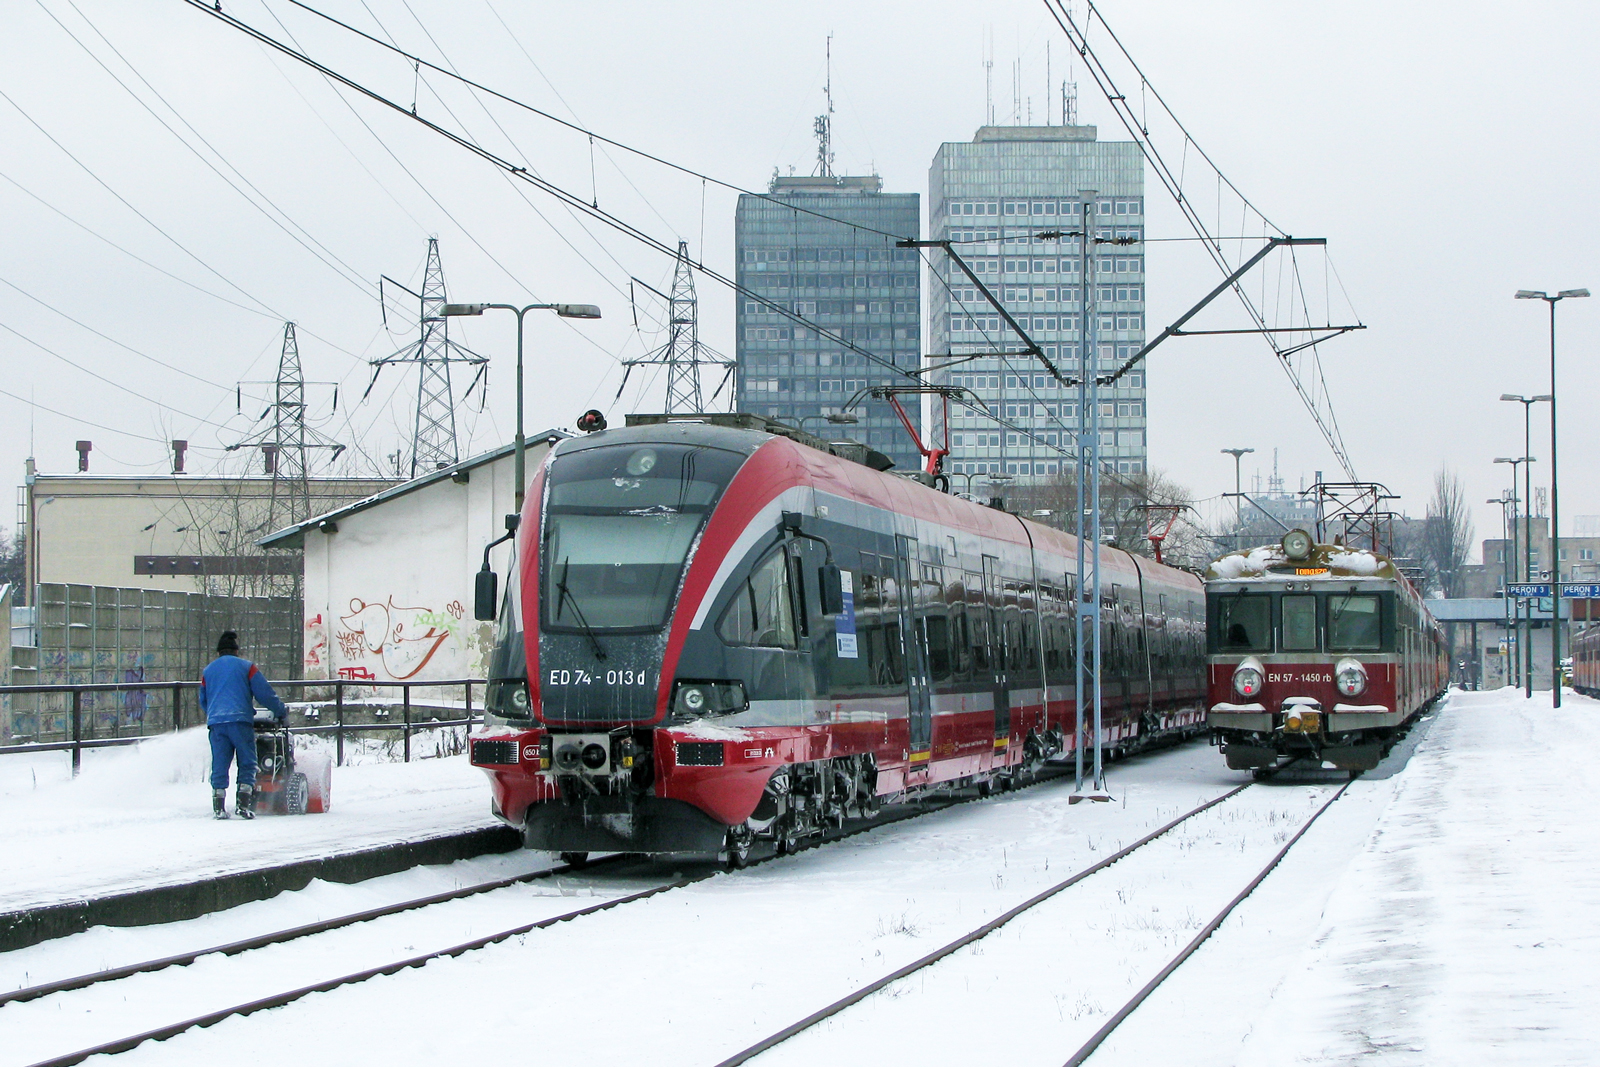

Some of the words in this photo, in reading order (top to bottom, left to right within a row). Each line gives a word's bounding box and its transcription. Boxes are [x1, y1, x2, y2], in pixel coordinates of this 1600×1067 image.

[549, 669, 571, 685] ED
[574, 669, 592, 685] 74
[606, 669, 634, 685] 013
[637, 669, 646, 685] d
[1268, 673, 1281, 683] EN
[1282, 673, 1293, 683] 57
[1301, 673, 1321, 683] 1450
[1322, 673, 1332, 683] rb
